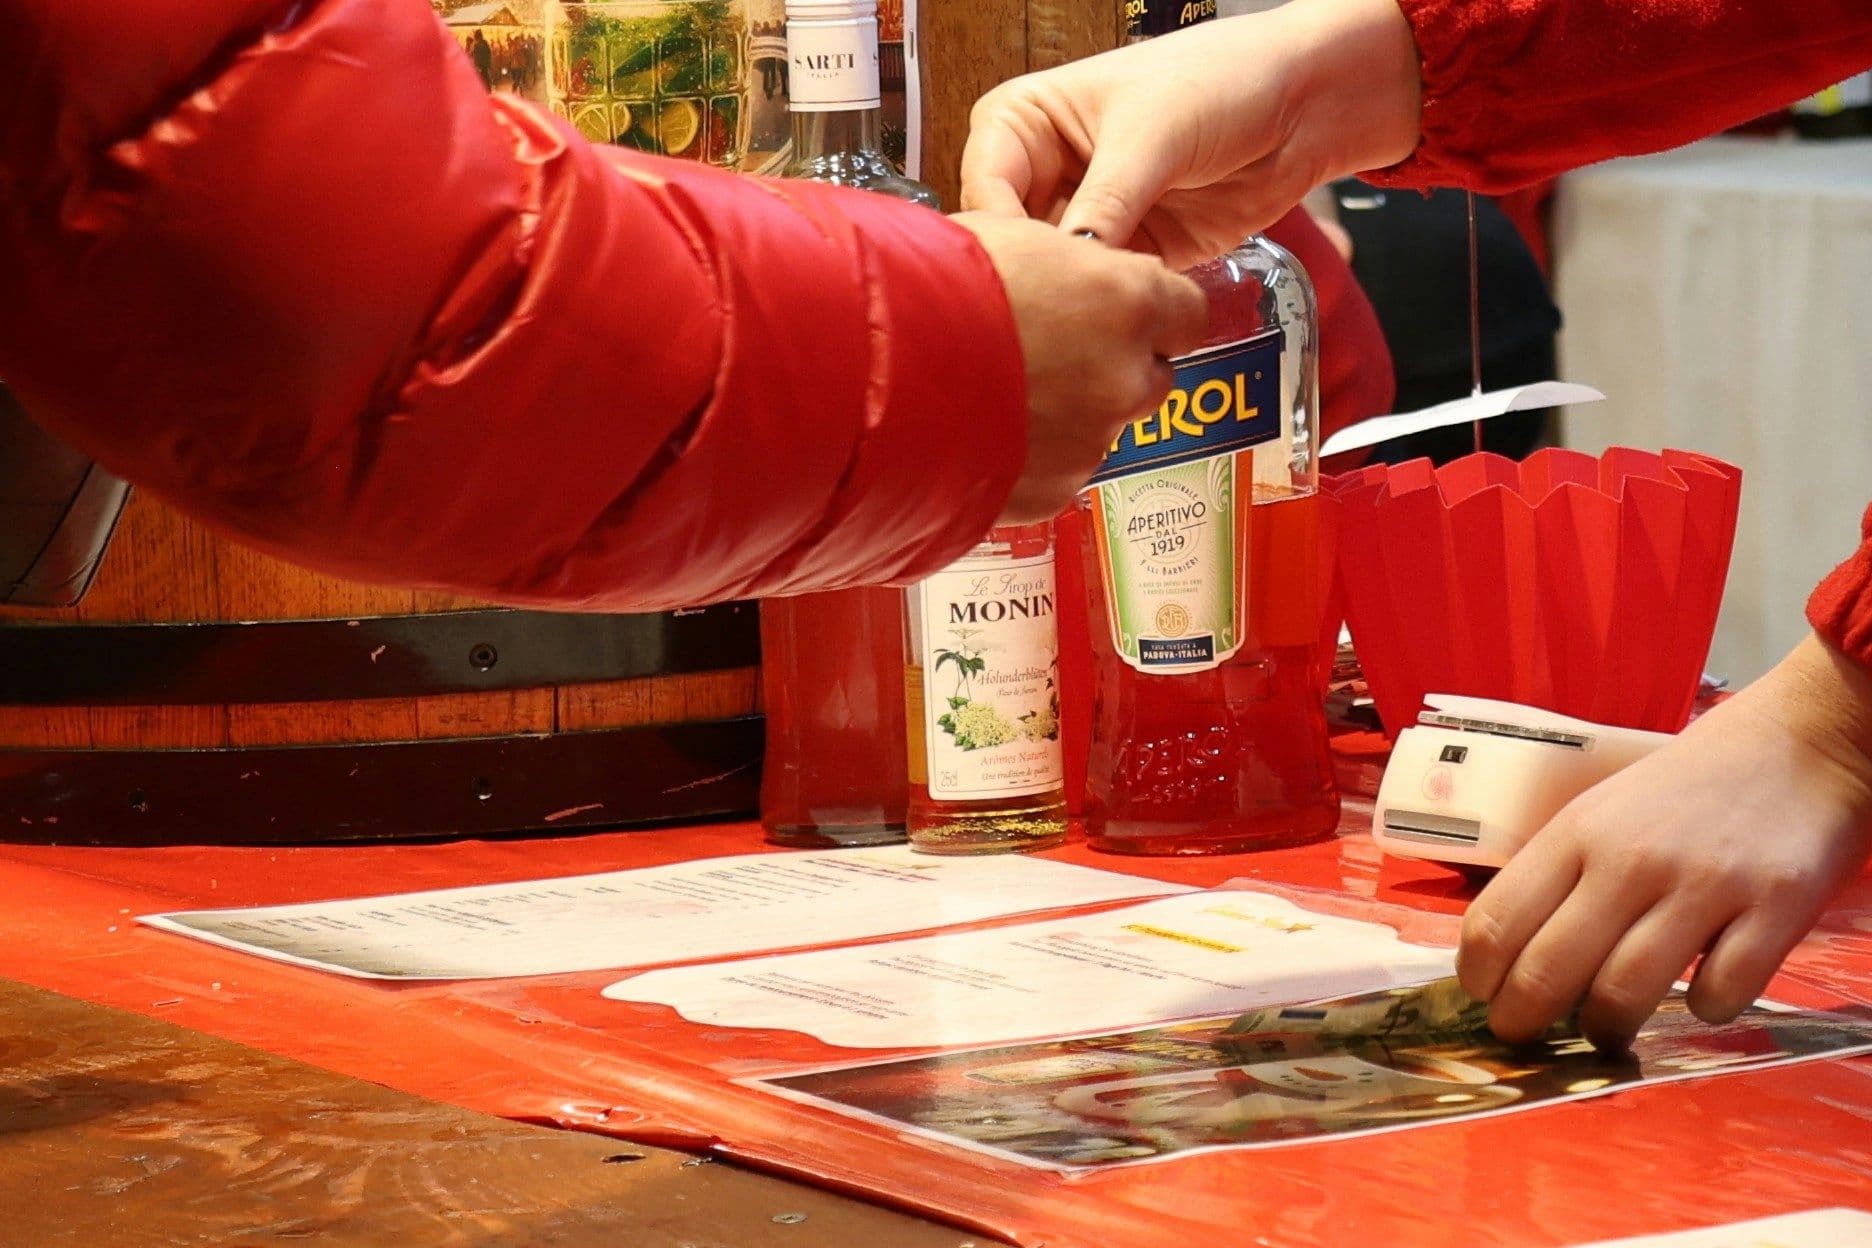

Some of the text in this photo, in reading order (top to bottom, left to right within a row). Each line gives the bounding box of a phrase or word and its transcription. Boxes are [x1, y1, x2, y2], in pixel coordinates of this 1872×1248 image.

[794, 53, 855, 71] SARTI
[1102, 372, 1259, 460] EROL
[1127, 501, 1206, 536] APERITIVO
[1151, 535, 1185, 557] 1919
[1155, 527, 1178, 539] DAL
[949, 592, 1055, 624] MONIN
